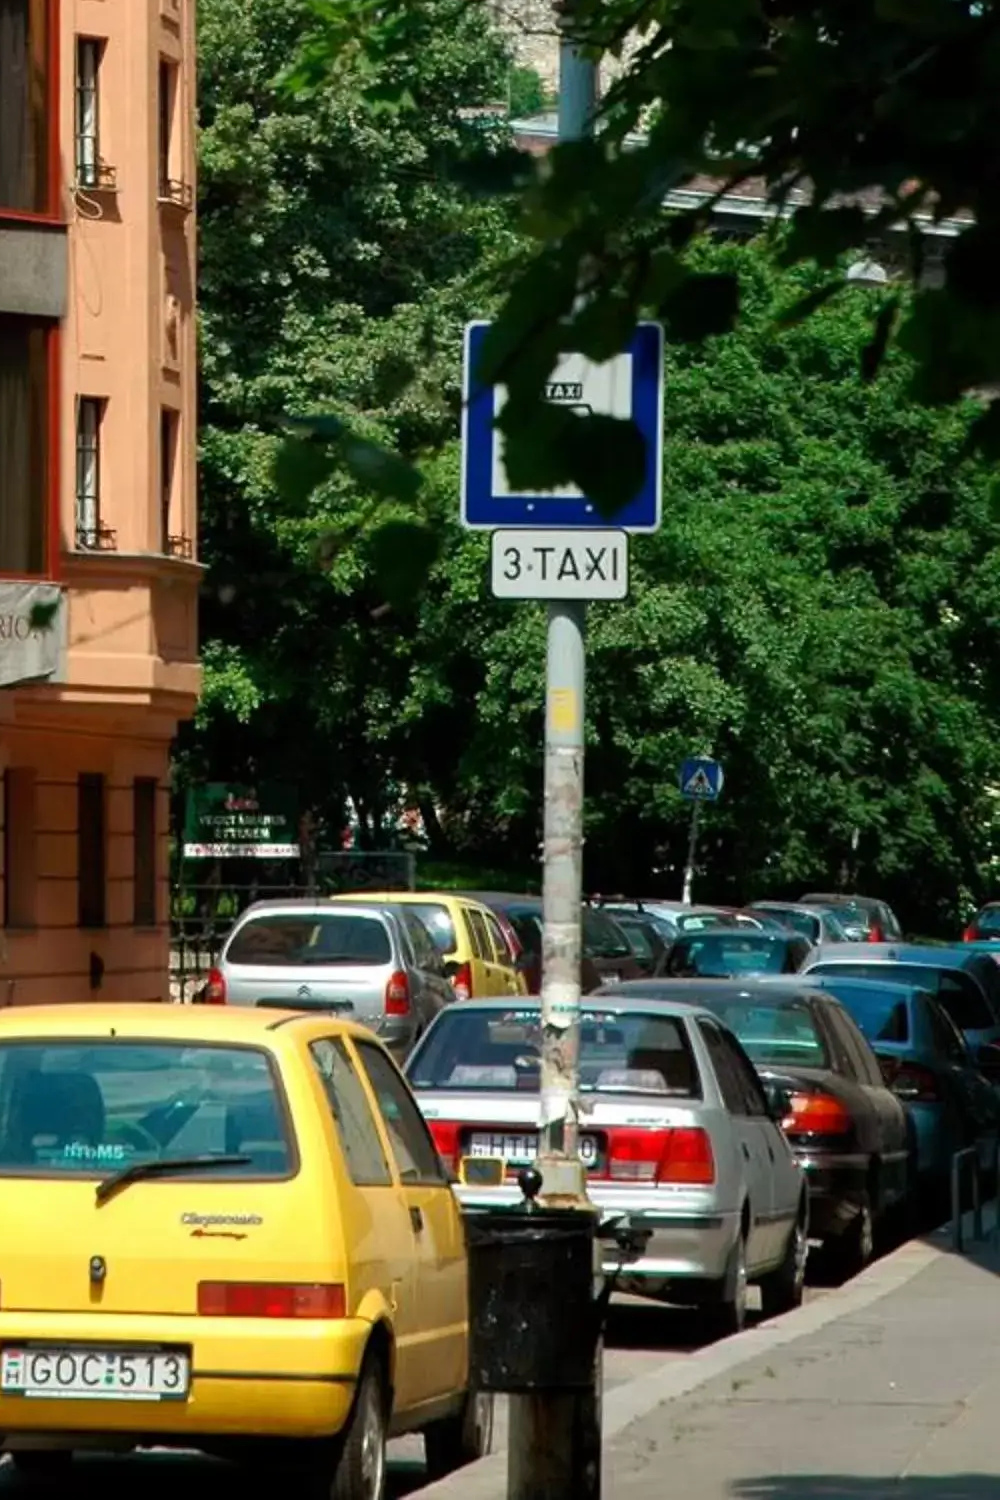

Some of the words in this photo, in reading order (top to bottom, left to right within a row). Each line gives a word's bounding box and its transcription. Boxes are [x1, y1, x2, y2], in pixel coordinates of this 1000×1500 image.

[545, 383, 582, 399] TAXI
[503, 547, 522, 581] 3
[533, 547, 618, 581] TAXI
